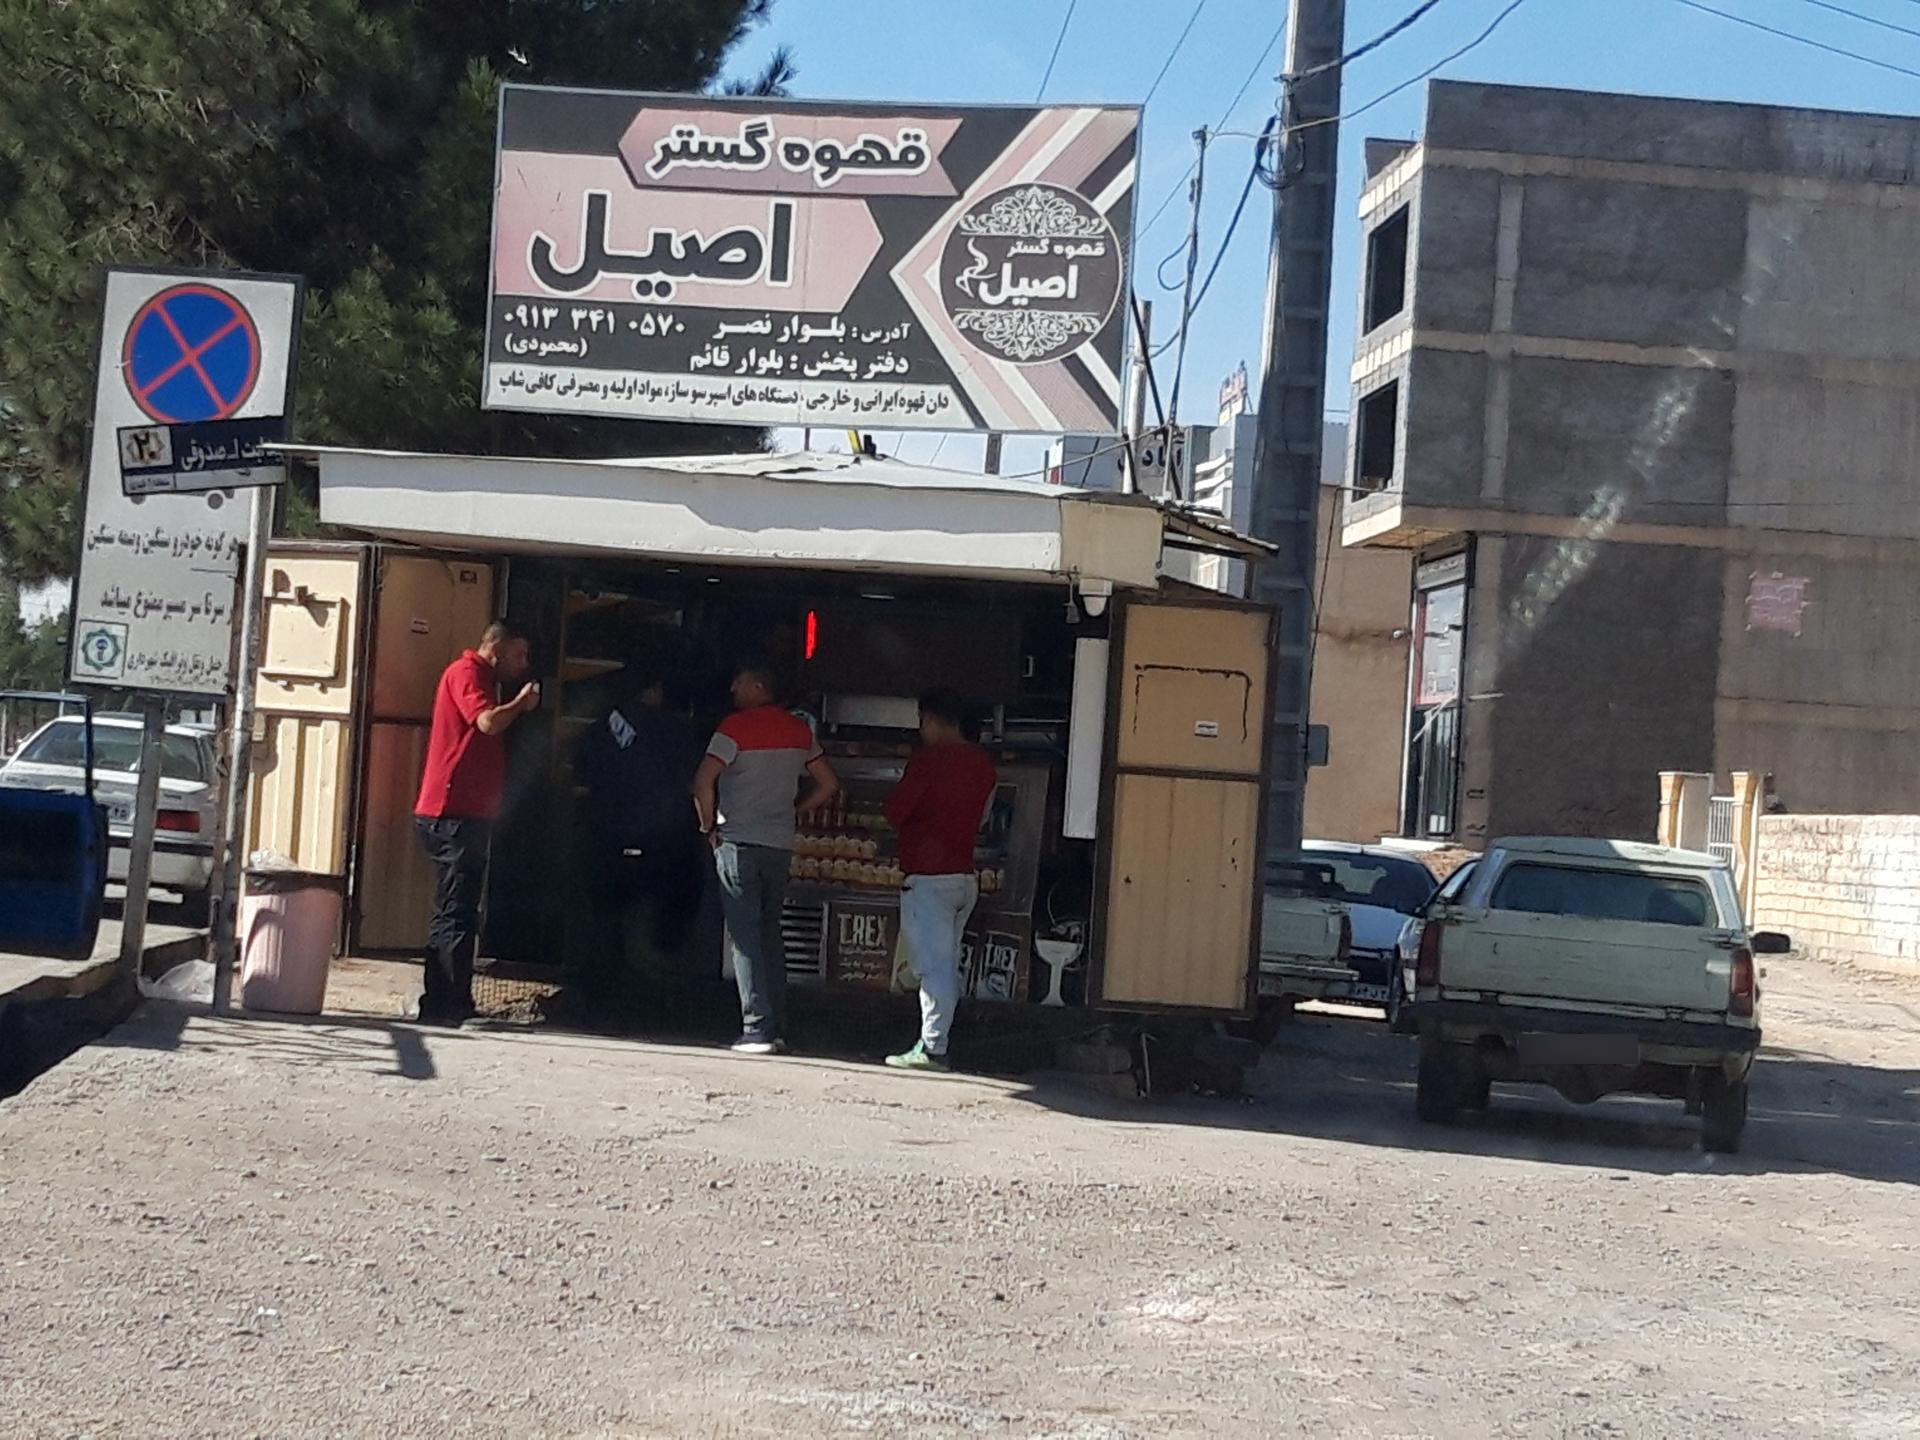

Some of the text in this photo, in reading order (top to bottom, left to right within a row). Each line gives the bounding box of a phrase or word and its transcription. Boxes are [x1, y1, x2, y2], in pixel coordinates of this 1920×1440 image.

[649, 119, 929, 184] قهوه گستر
[529, 190, 796, 300] اصیل
[1006, 238, 1105, 260] قهوه گستر
[978, 262, 1079, 306] اصیل
[503, 303, 686, 337] ۰۹۱۳ ۳۴۱ ۰۵۷۰
[711, 312, 773, 340] نصر
[776, 314, 847, 343] بلوار
[503, 332, 588, 358] (محمودی)
[689, 342, 730, 372] قائم
[734, 347, 784, 375] بلوار
[862, 350, 909, 380] دفتر
[498, 368, 525, 393] شاپ
[609, 377, 638, 400] اولیه
[638, 379, 663, 400] مواد
[732, 384, 757, 406] های
[758, 385, 799, 405] دستگاه
[852, 397, 860, 413] و
[860, 387, 899, 412] ایرانی
[899, 390, 926, 414] قهوه
[926, 391, 949, 415] دان
